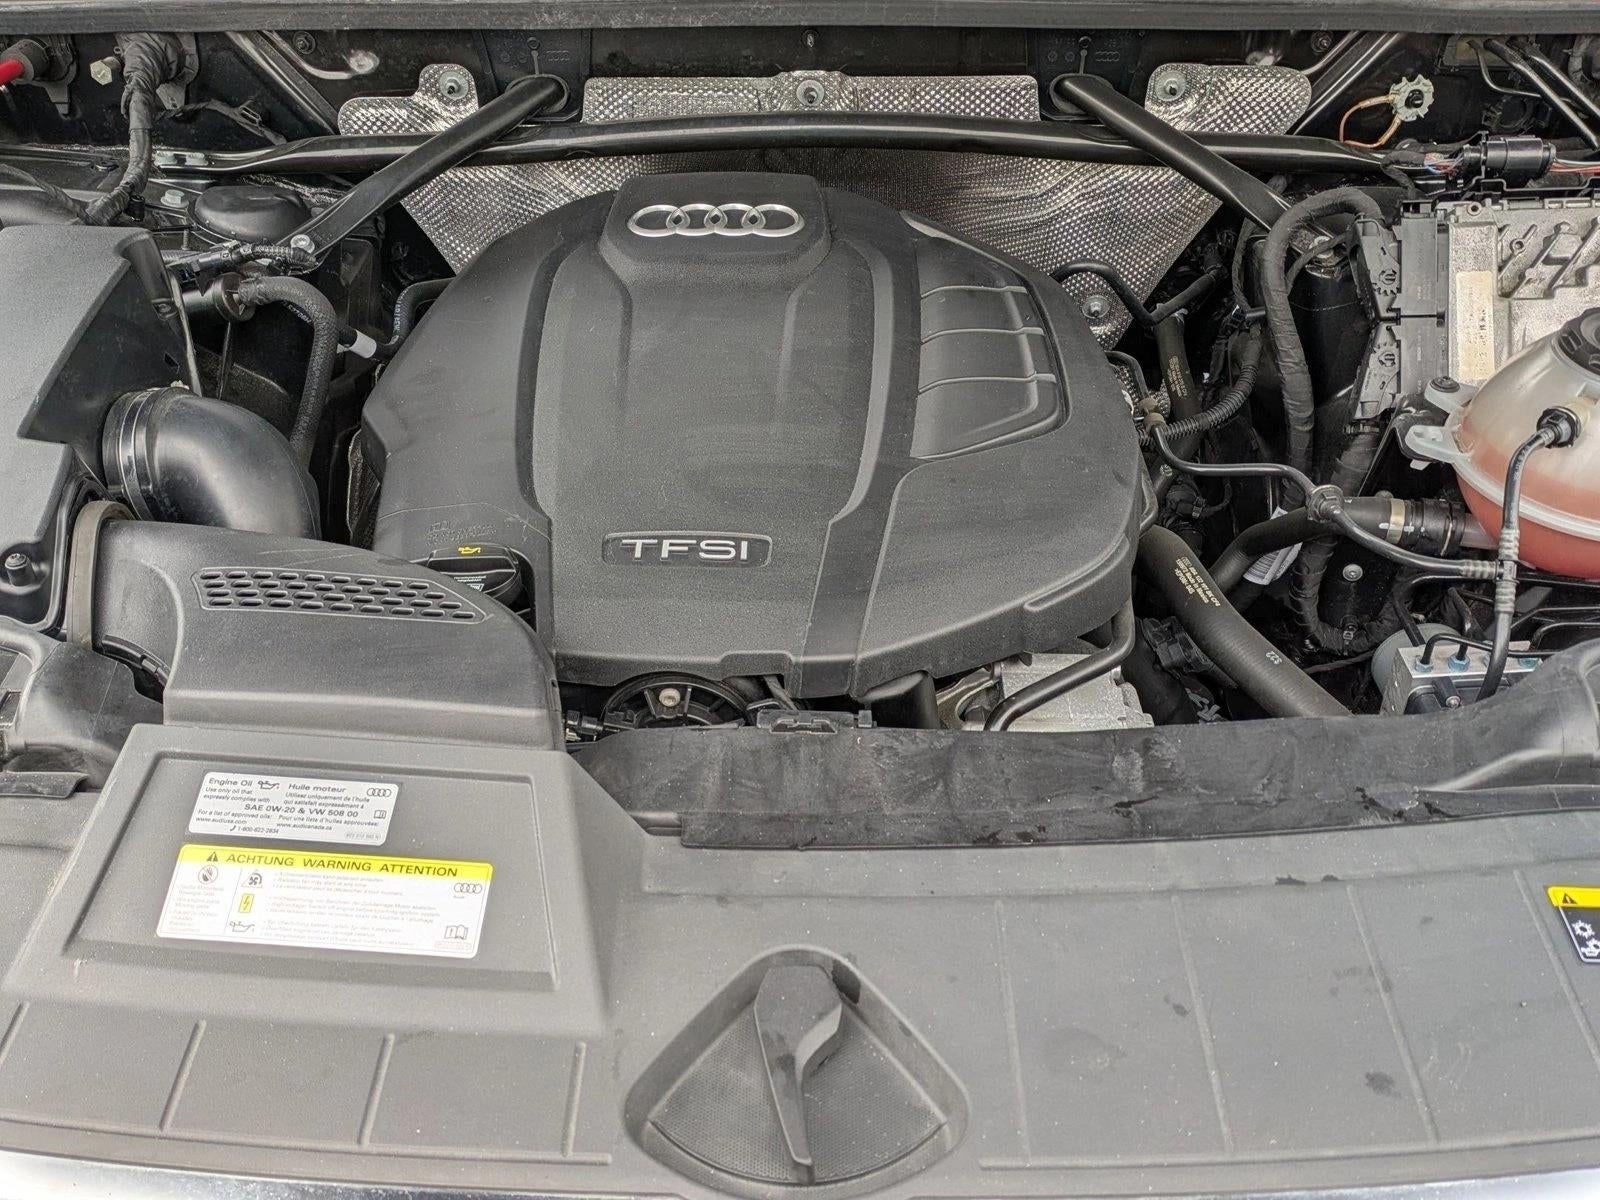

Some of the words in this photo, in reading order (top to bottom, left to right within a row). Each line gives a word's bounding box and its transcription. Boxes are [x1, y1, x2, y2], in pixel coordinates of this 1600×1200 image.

[621, 539, 748, 561] TFSI
[209, 778, 238, 786] Engine
[266, 805, 295, 813] 0W-20
[226, 854, 294, 866] ACHTUNG
[303, 858, 372, 872] WARNING
[379, 863, 458, 877] ATTENTION
